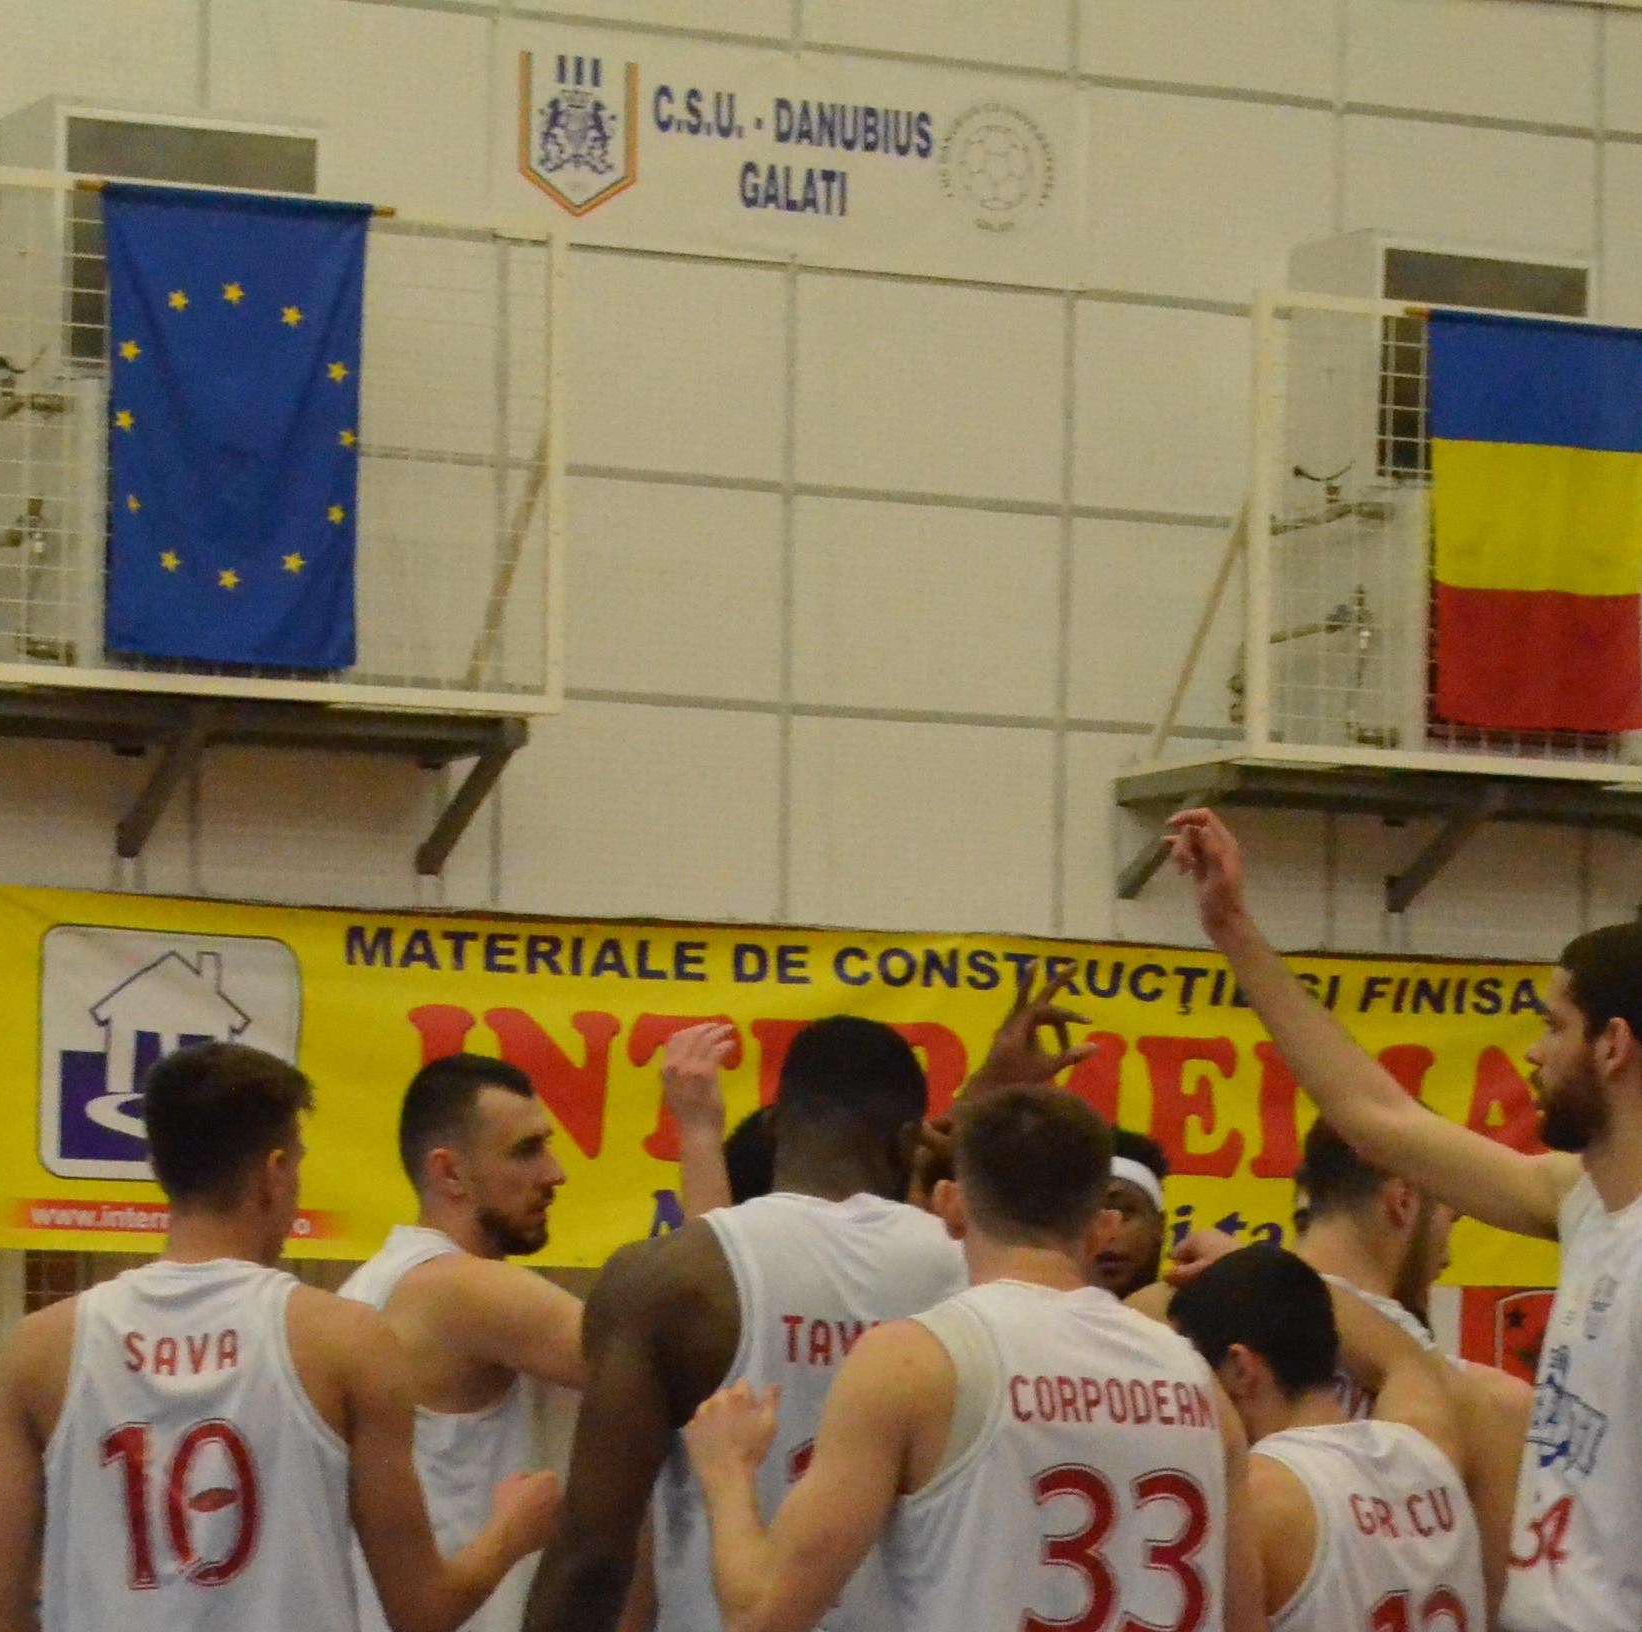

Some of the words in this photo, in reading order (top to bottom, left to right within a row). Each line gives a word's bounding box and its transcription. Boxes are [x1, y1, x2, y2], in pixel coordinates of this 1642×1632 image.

[653, 85, 743, 138] C.S.U.
[773, 98, 934, 157] DANUBIUS
[739, 162, 848, 216] GALATI
[344, 924, 708, 982] MATERIALE
[732, 943, 811, 985] DE
[1357, 976, 1550, 1016] FINISA
[123, 1328, 239, 1376] SAVA
[99, 1416, 259, 1591] 10
[1349, 1486, 1456, 1540] GRCU
